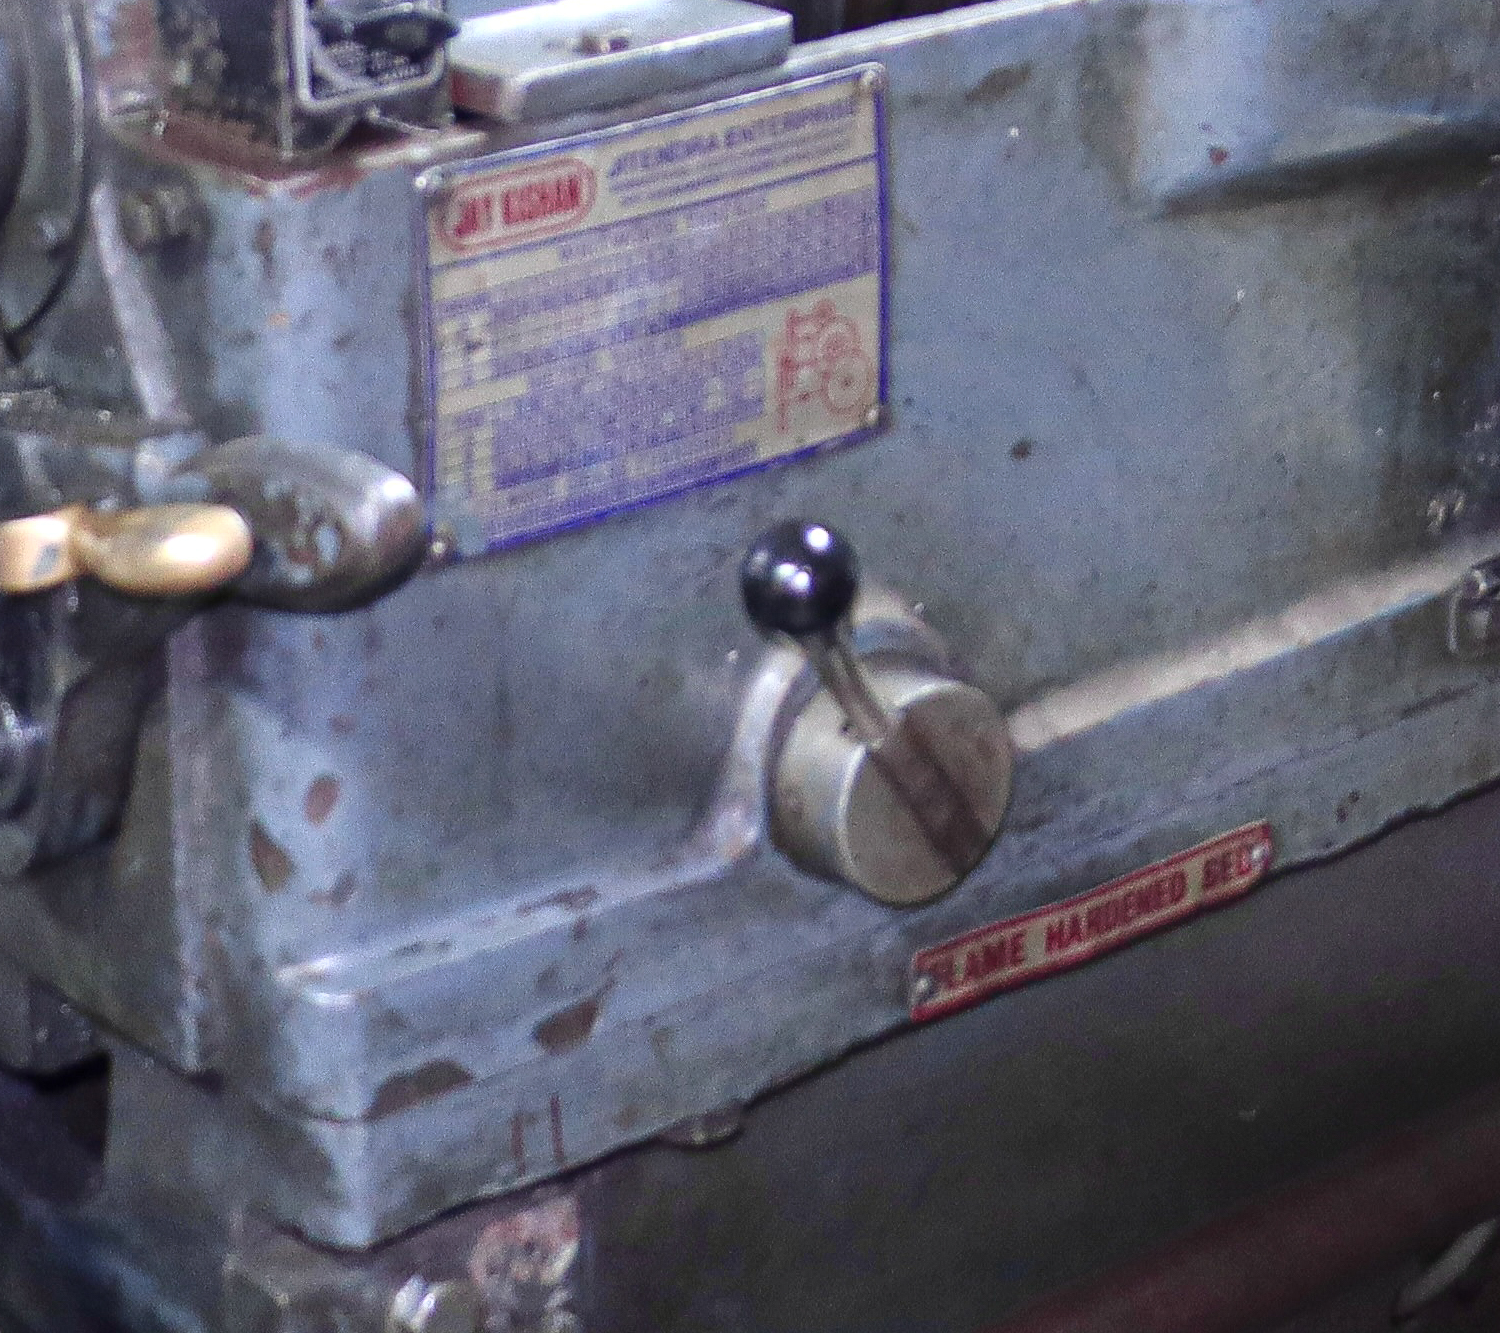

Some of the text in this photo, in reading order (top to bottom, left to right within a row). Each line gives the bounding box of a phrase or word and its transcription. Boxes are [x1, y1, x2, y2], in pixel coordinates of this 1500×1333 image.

[930, 845, 1253, 988] FLAME HARDENED BED
